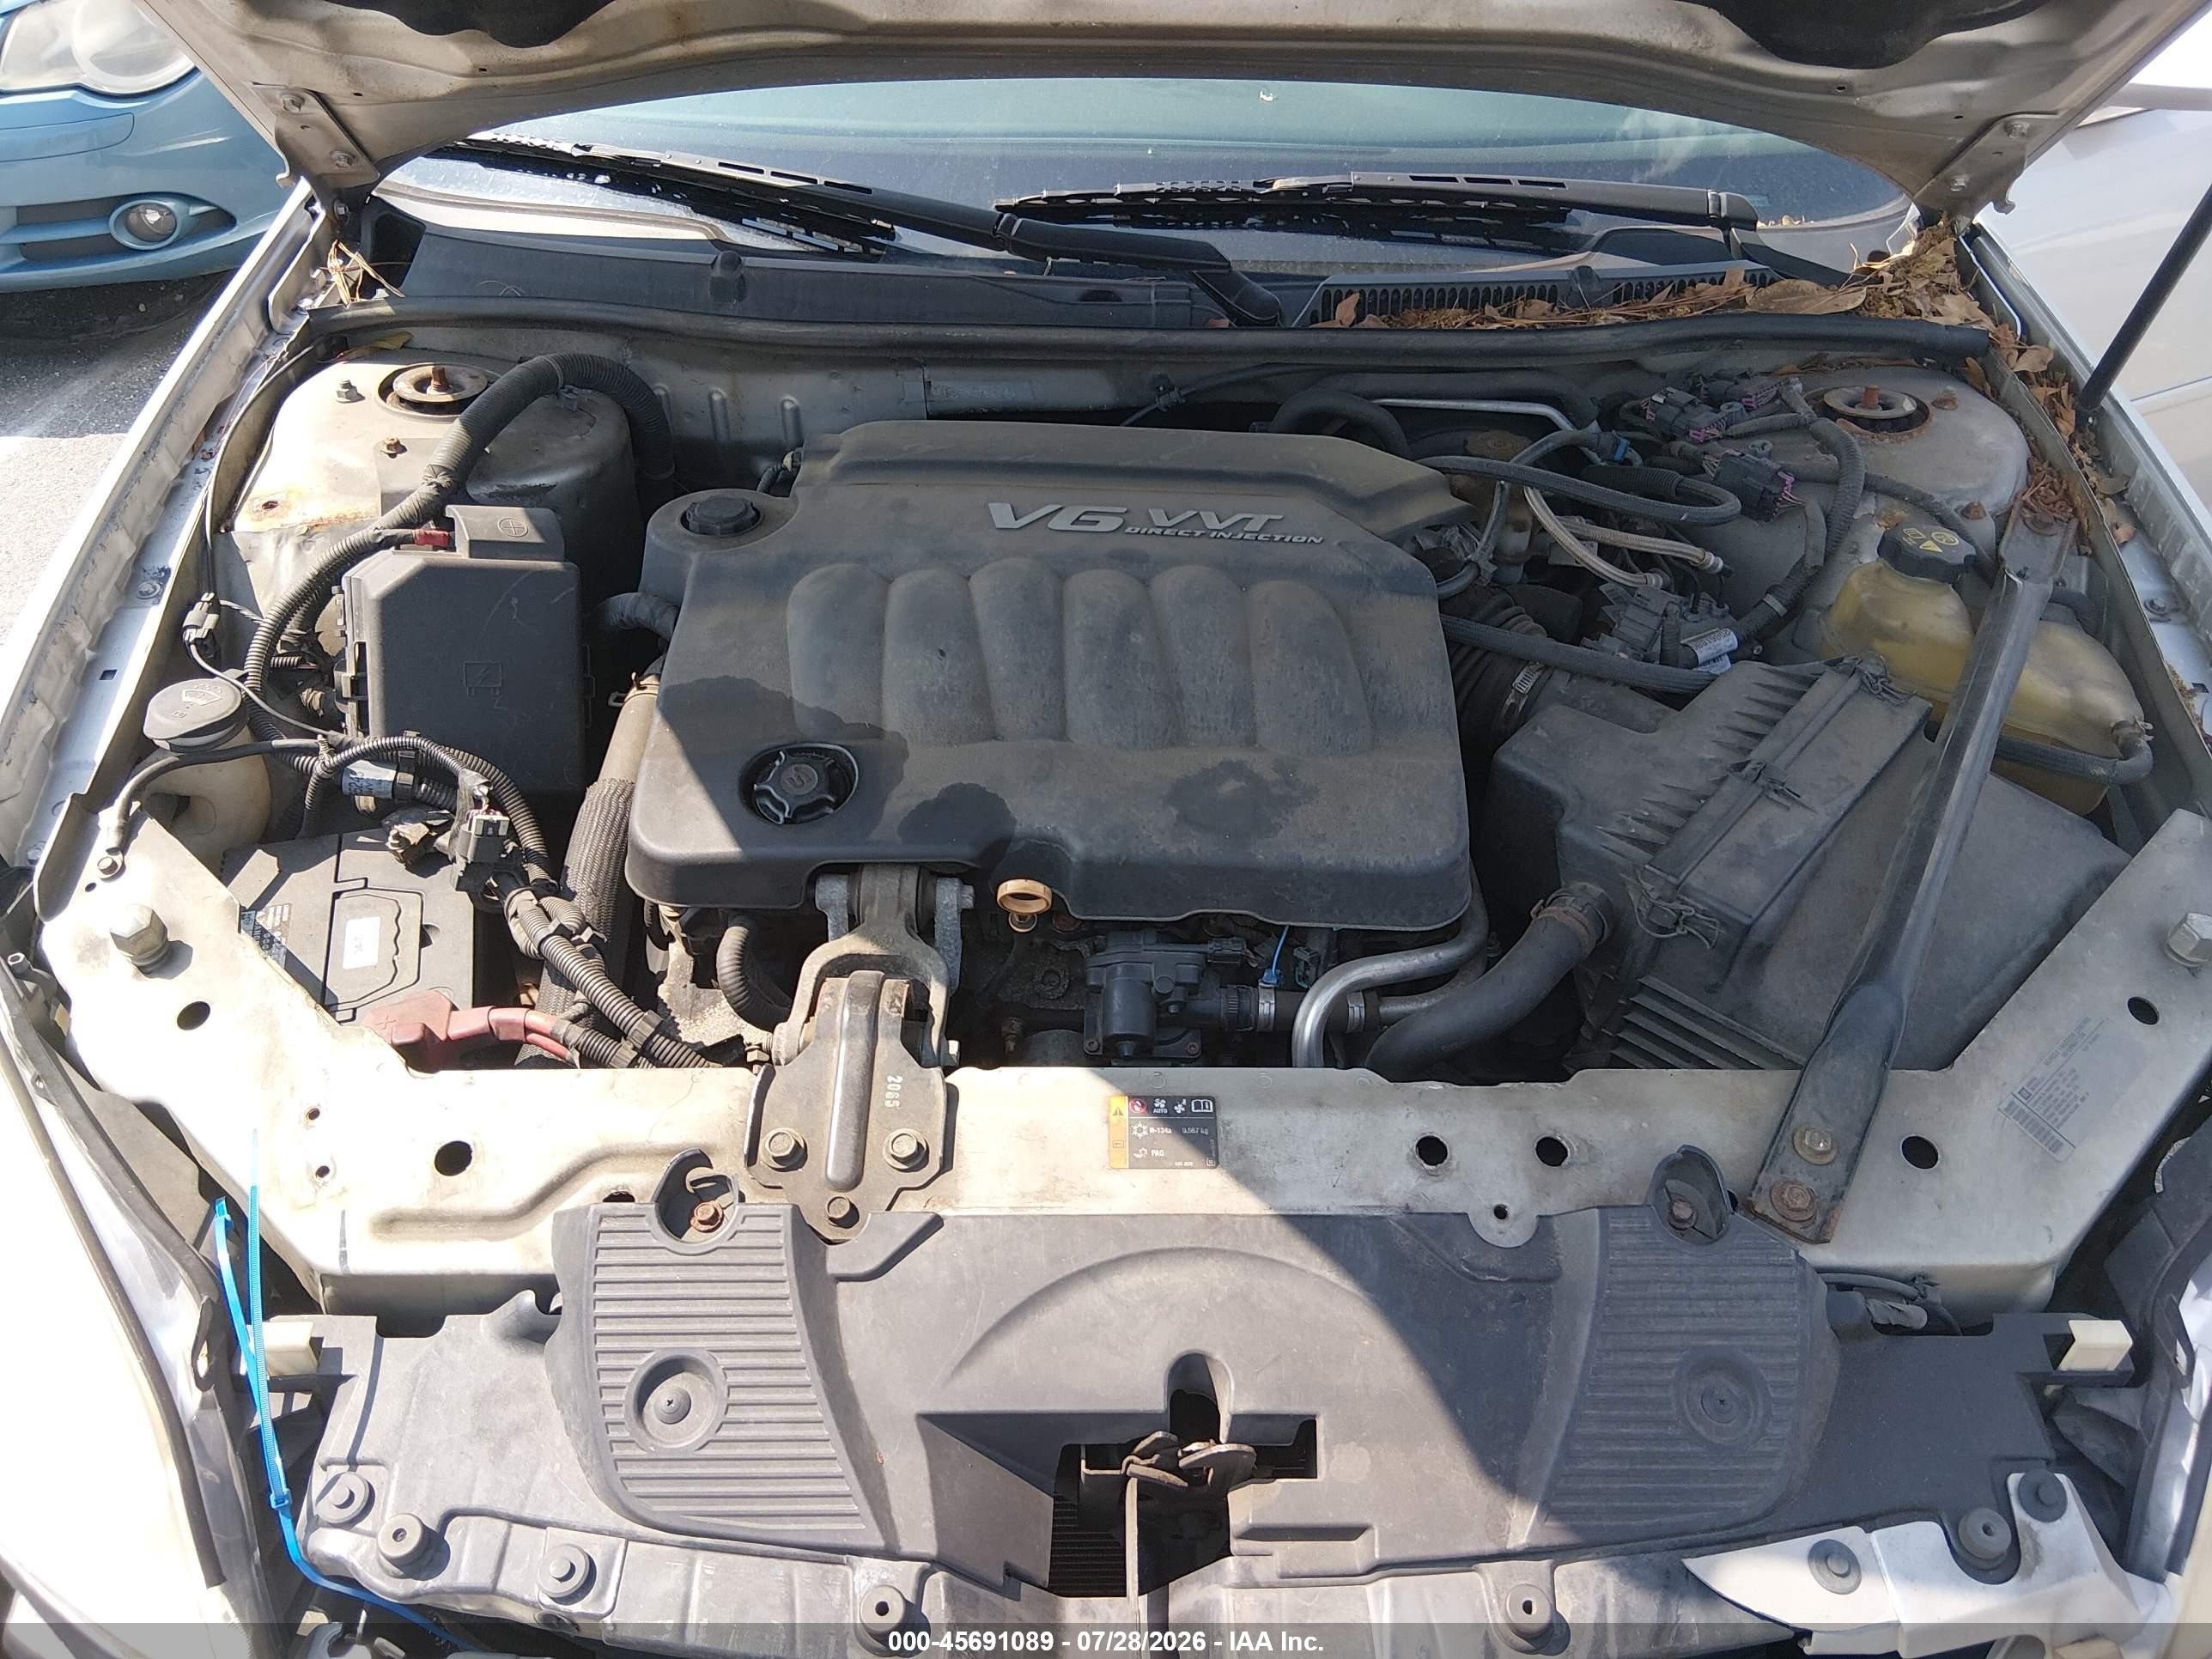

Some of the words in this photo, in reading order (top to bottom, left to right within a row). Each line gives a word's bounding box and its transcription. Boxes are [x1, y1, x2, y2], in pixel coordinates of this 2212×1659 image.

[988, 502, 1128, 532] V6
[1147, 507, 1284, 532] VVT
[1124, 526, 1206, 538] DIRECT
[1209, 530, 1324, 544] INJECTION
[884, 1074, 903, 1108] 2065
[1151, 1149, 1164, 1158] PAG
